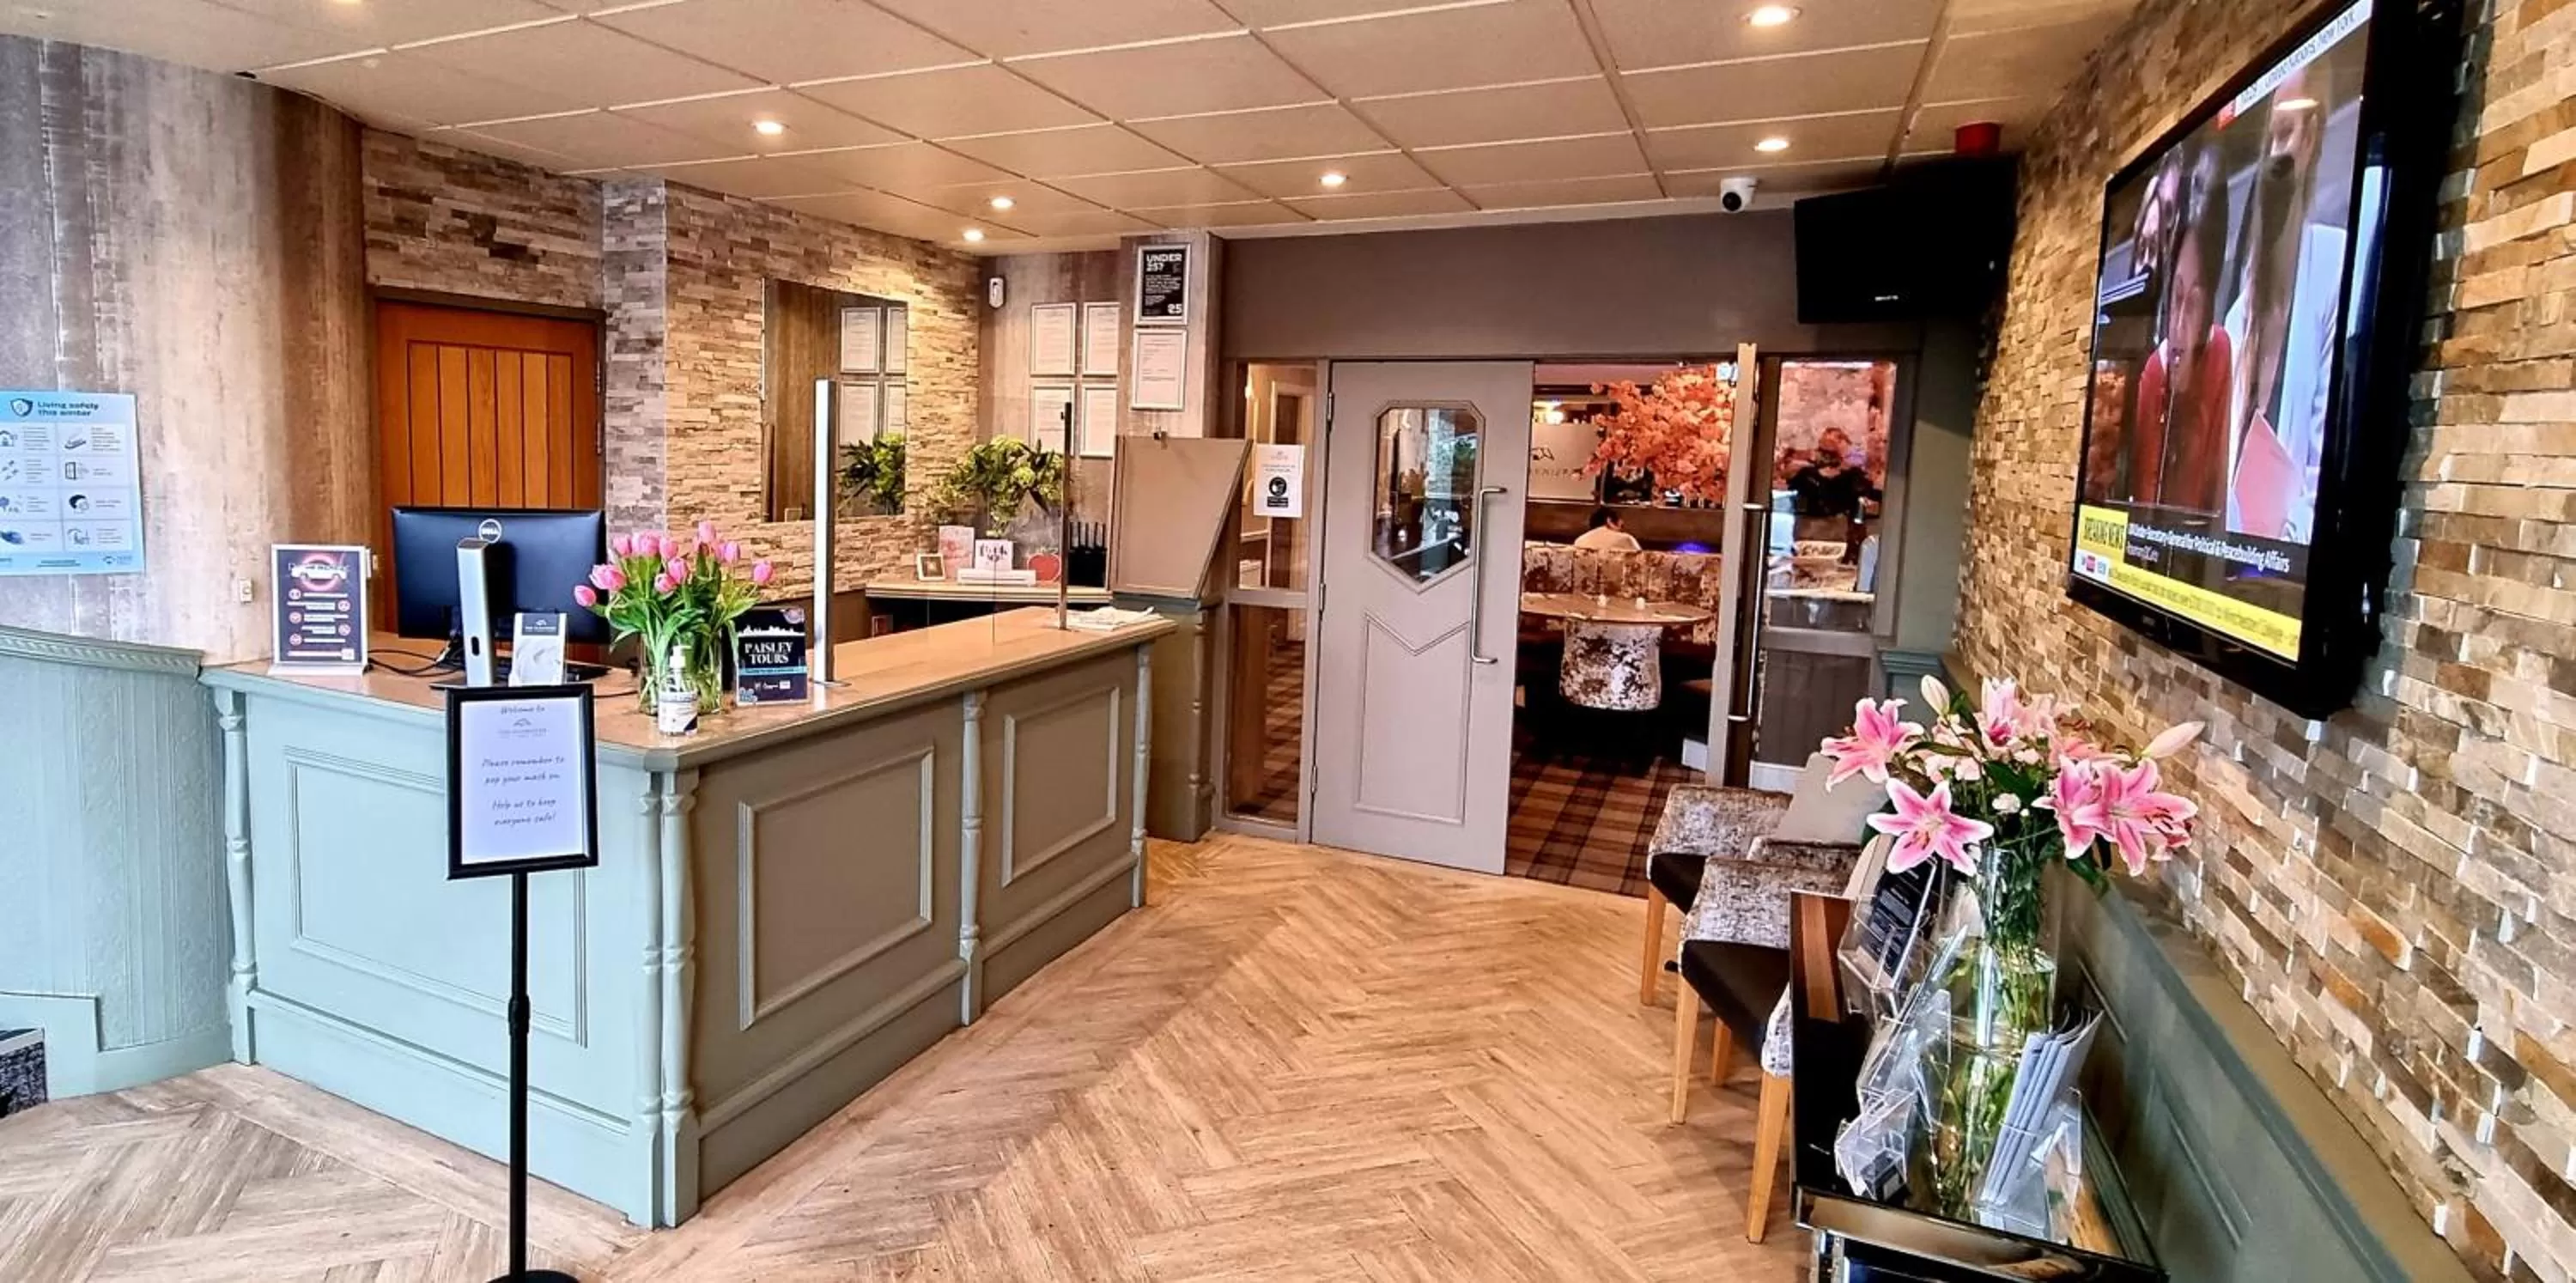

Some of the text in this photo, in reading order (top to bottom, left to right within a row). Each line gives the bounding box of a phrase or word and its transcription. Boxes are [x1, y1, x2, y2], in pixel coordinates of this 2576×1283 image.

[1146, 252, 1182, 262] UNDER
[38, 401, 66, 410] Living
[2264, 549, 2290, 573] Affairs
[744, 642, 793, 654] PAISLEY
[749, 654, 789, 665] TOURS
[482, 757, 508, 768] Please
[511, 756, 552, 767] remember
[485, 776, 500, 787] pop
[501, 775, 522, 787] your
[524, 770, 545, 781] mask
[491, 799, 511, 812] Help
[538, 797, 556, 808] keep
[494, 816, 531, 829] everyone
